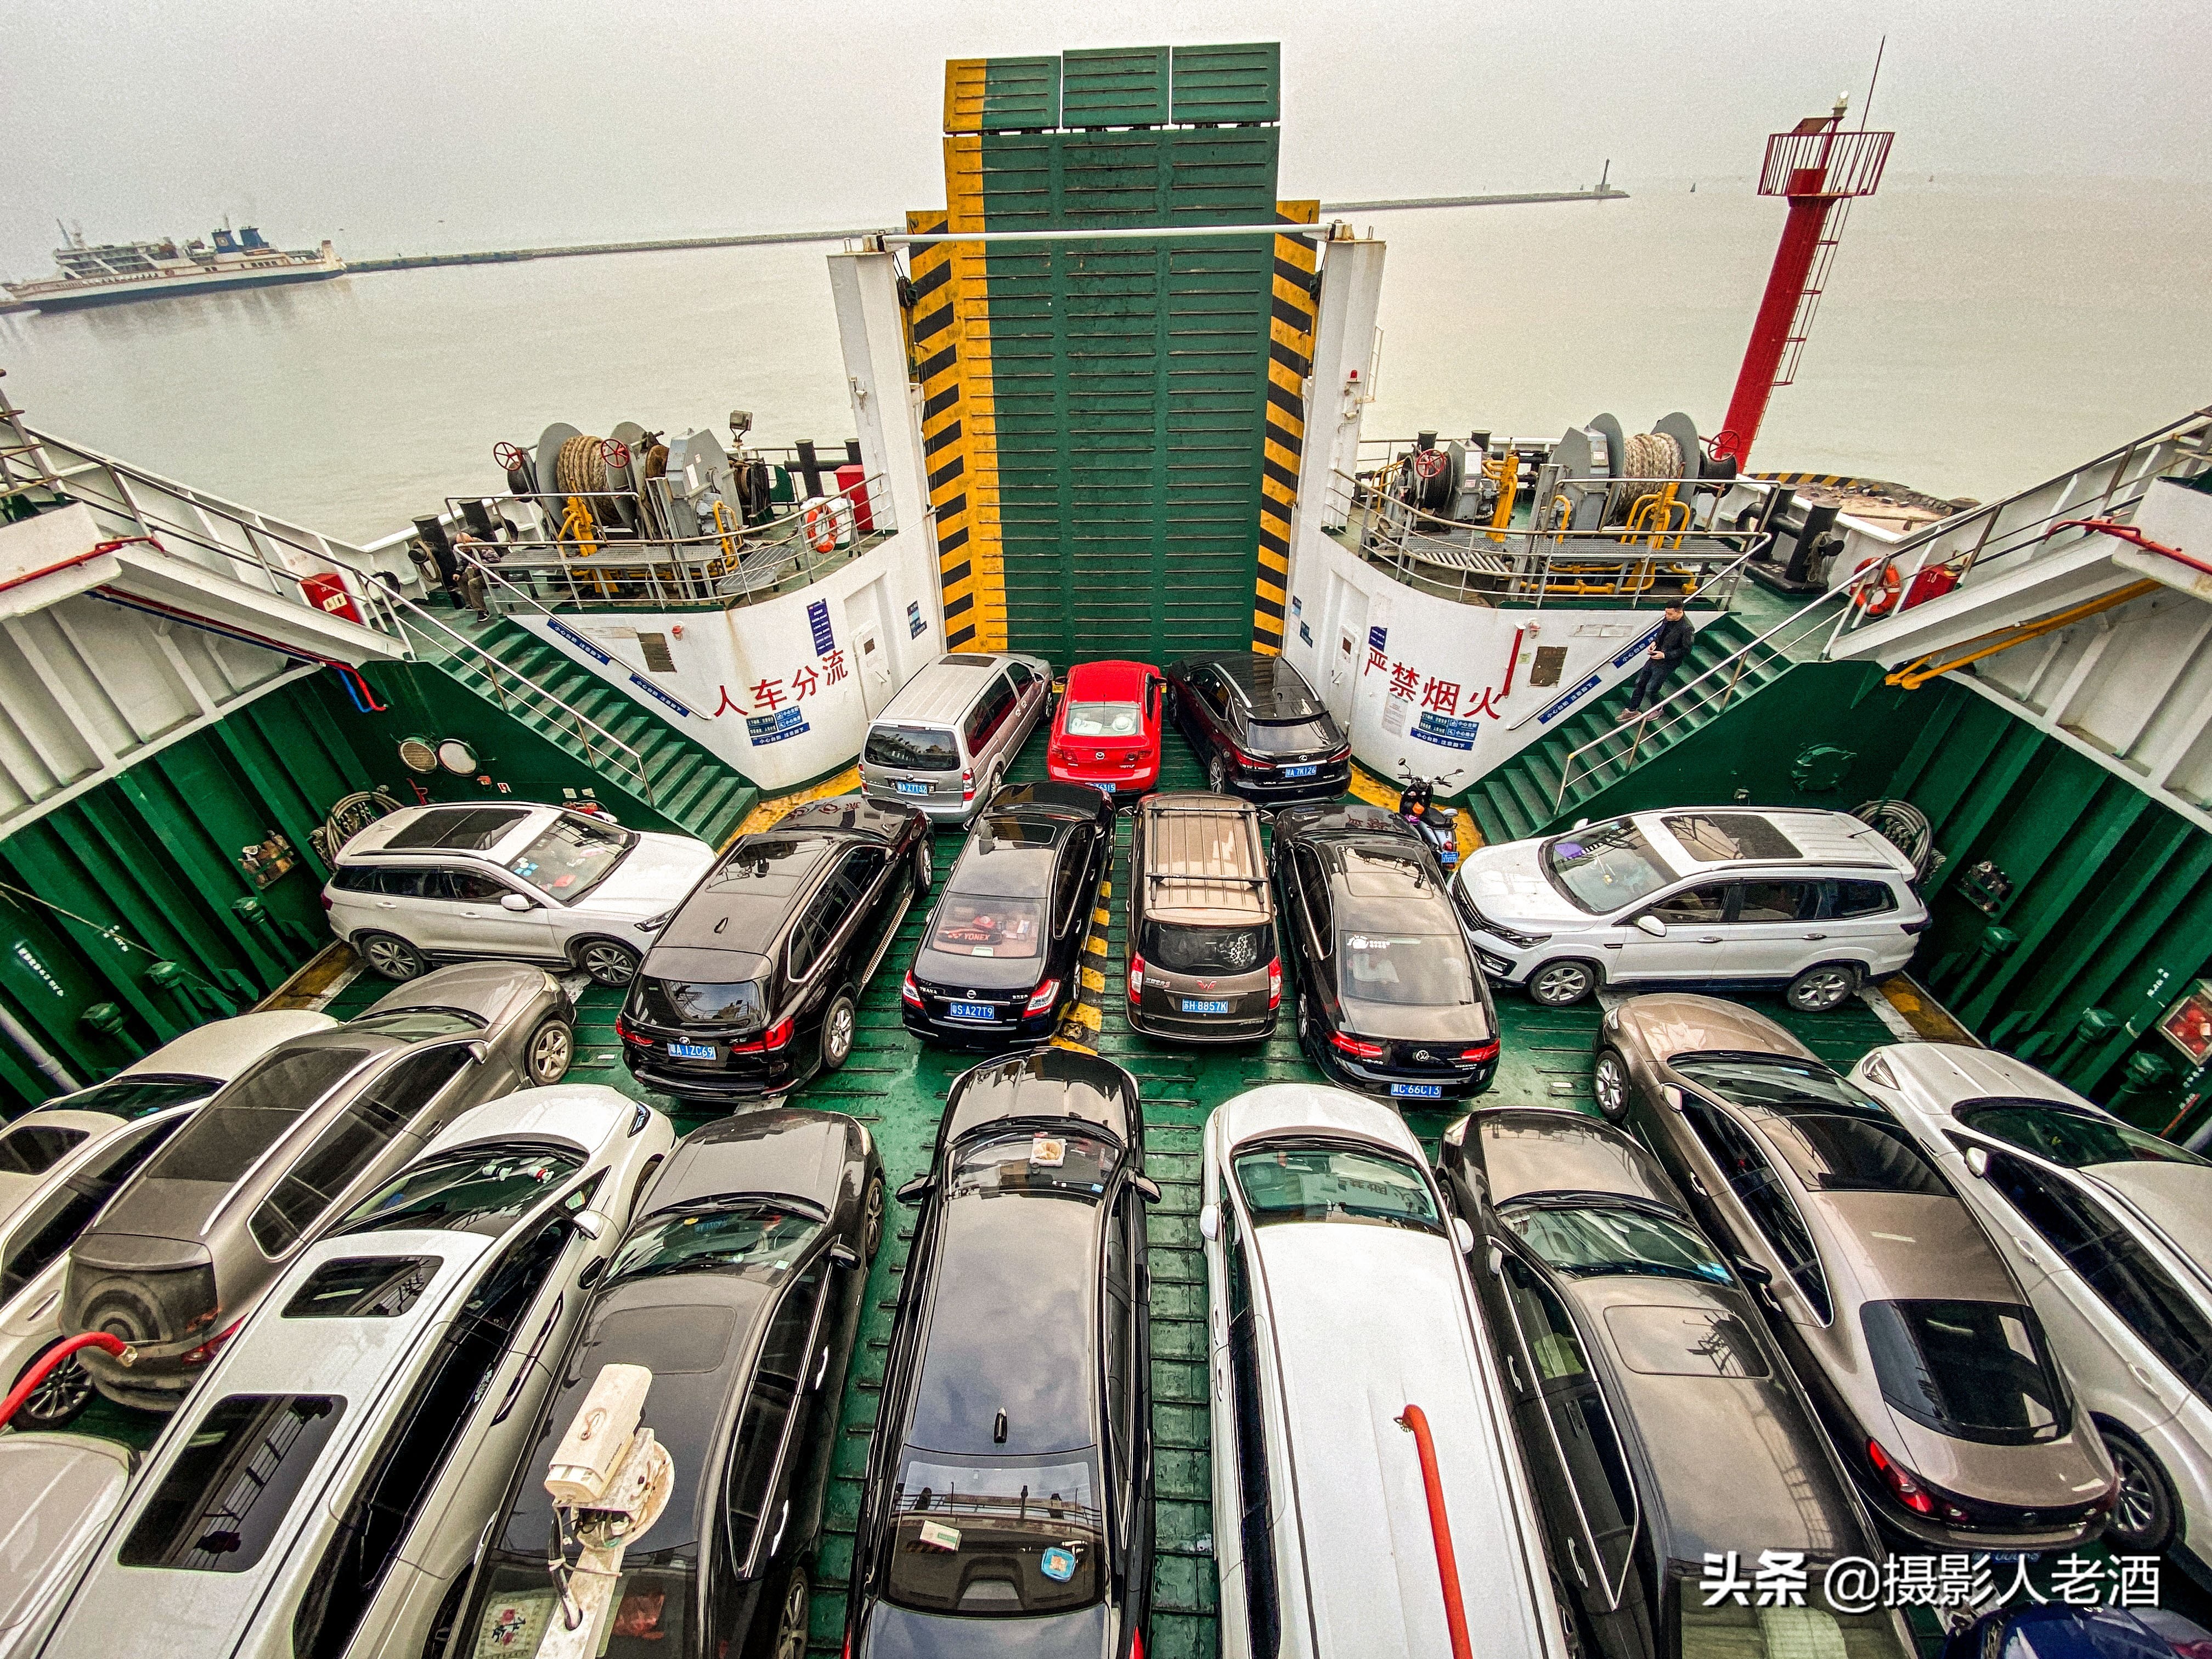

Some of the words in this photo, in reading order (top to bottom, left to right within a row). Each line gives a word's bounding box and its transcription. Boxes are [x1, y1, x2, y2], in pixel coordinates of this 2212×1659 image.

[713, 649, 849, 718] 人车分流
[1363, 646, 1502, 720] 严禁烟火
